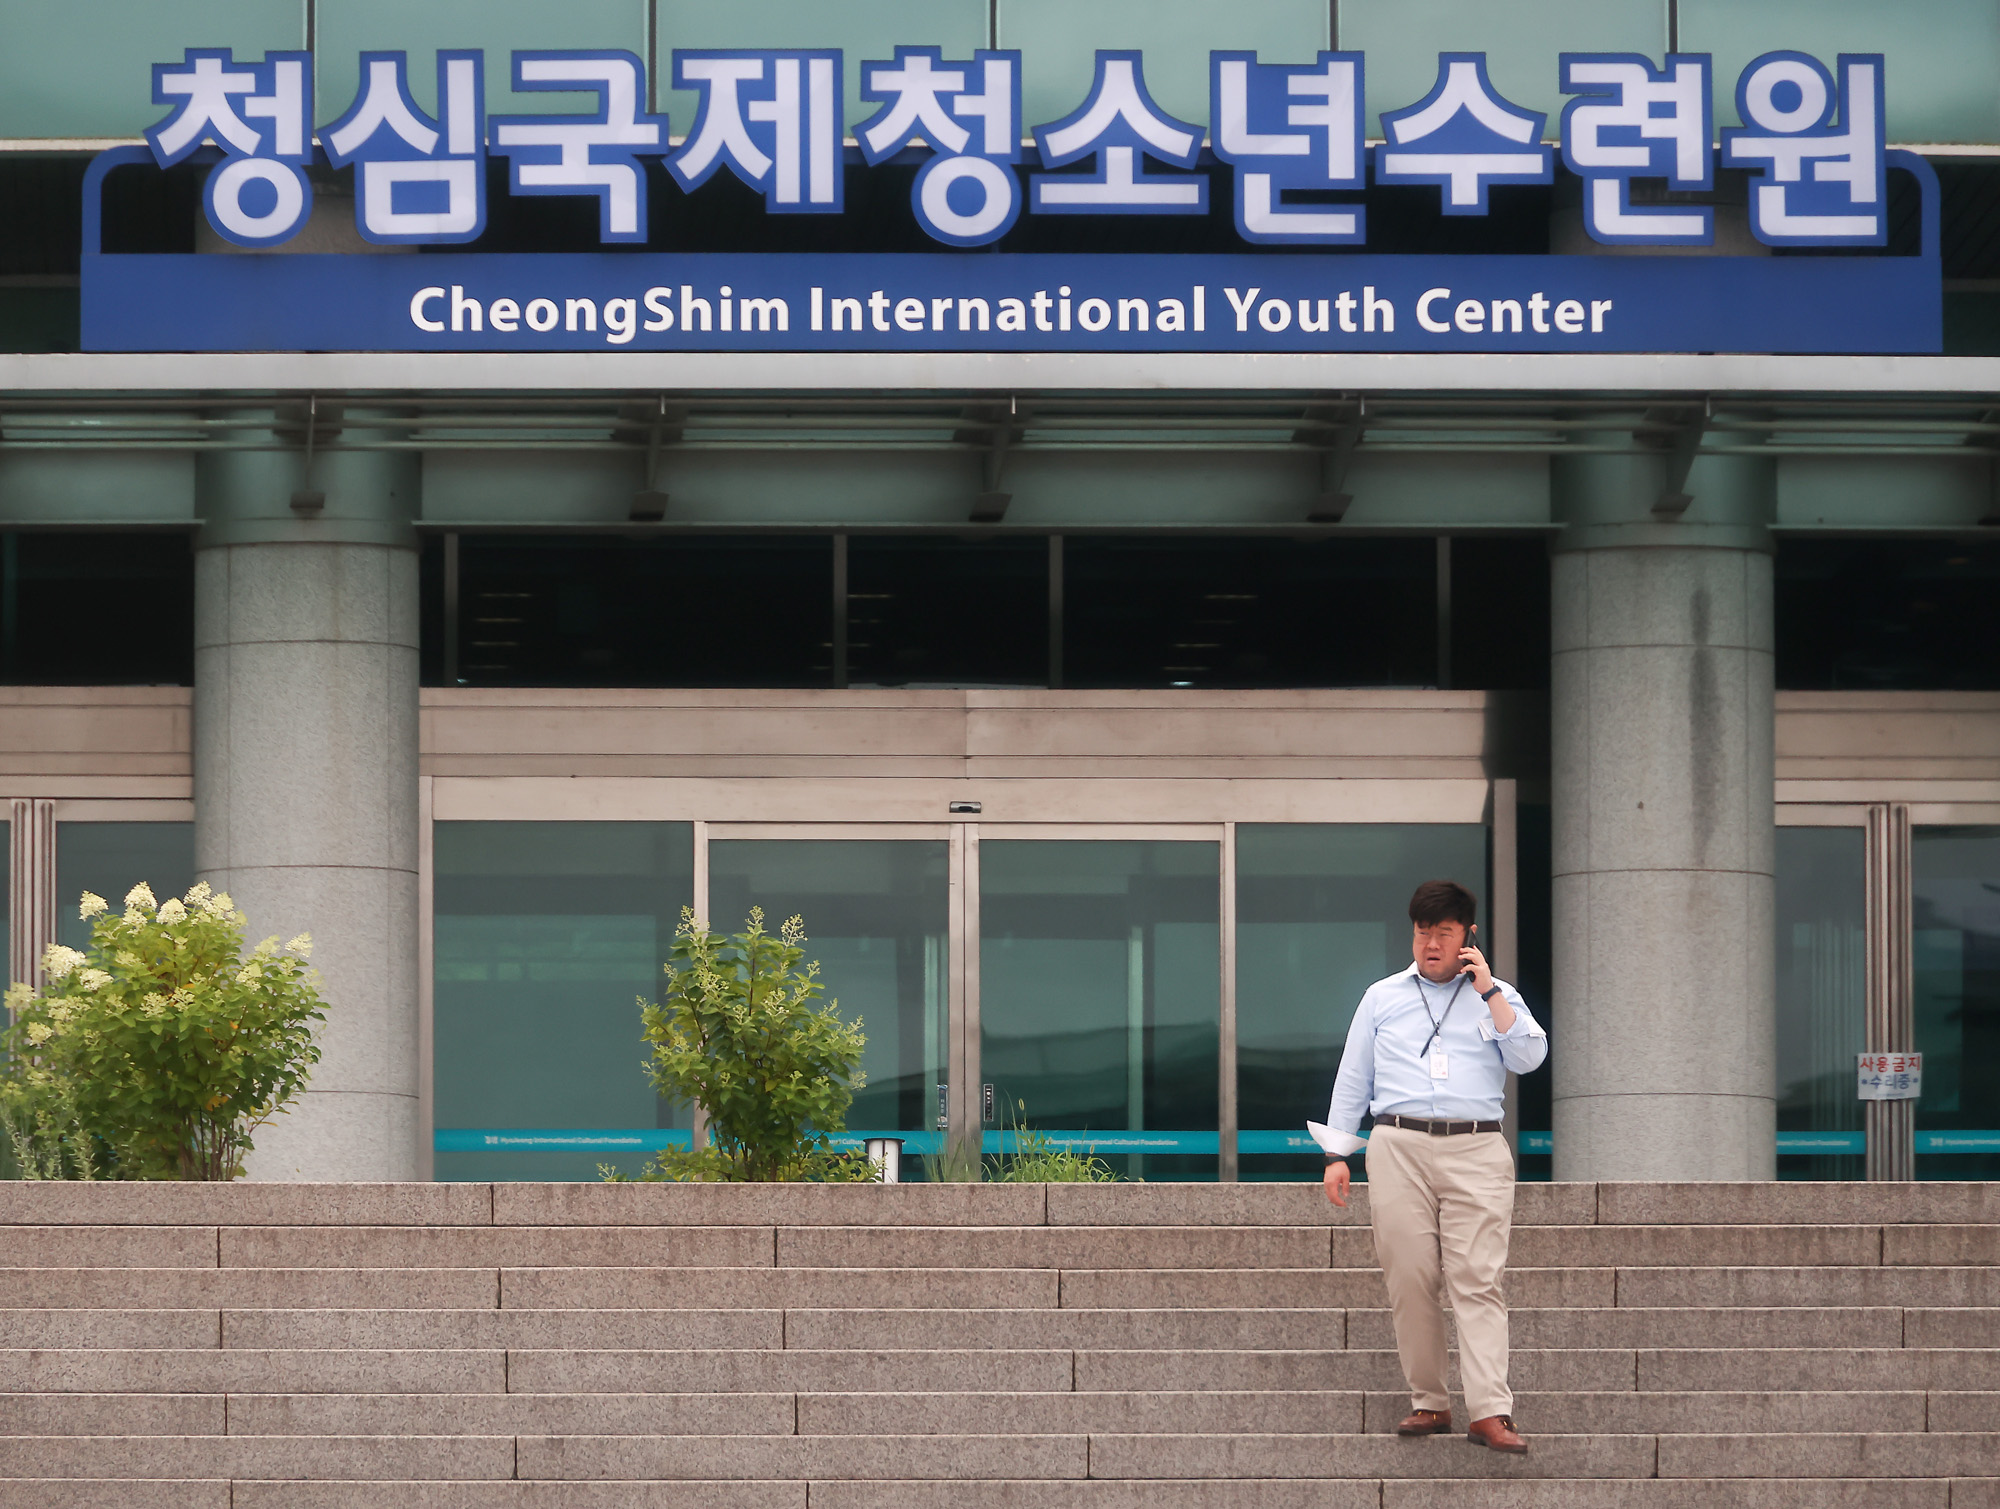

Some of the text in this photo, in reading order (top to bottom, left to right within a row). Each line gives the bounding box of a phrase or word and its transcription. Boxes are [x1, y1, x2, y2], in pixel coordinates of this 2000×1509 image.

[146, 46, 1887, 247] 청심국제청소년수련원
[410, 285, 1613, 345] CheongShim International Youth Center
[1860, 1056, 1920, 1072] 사용금지
[1870, 1074, 1910, 1089] 수리중
